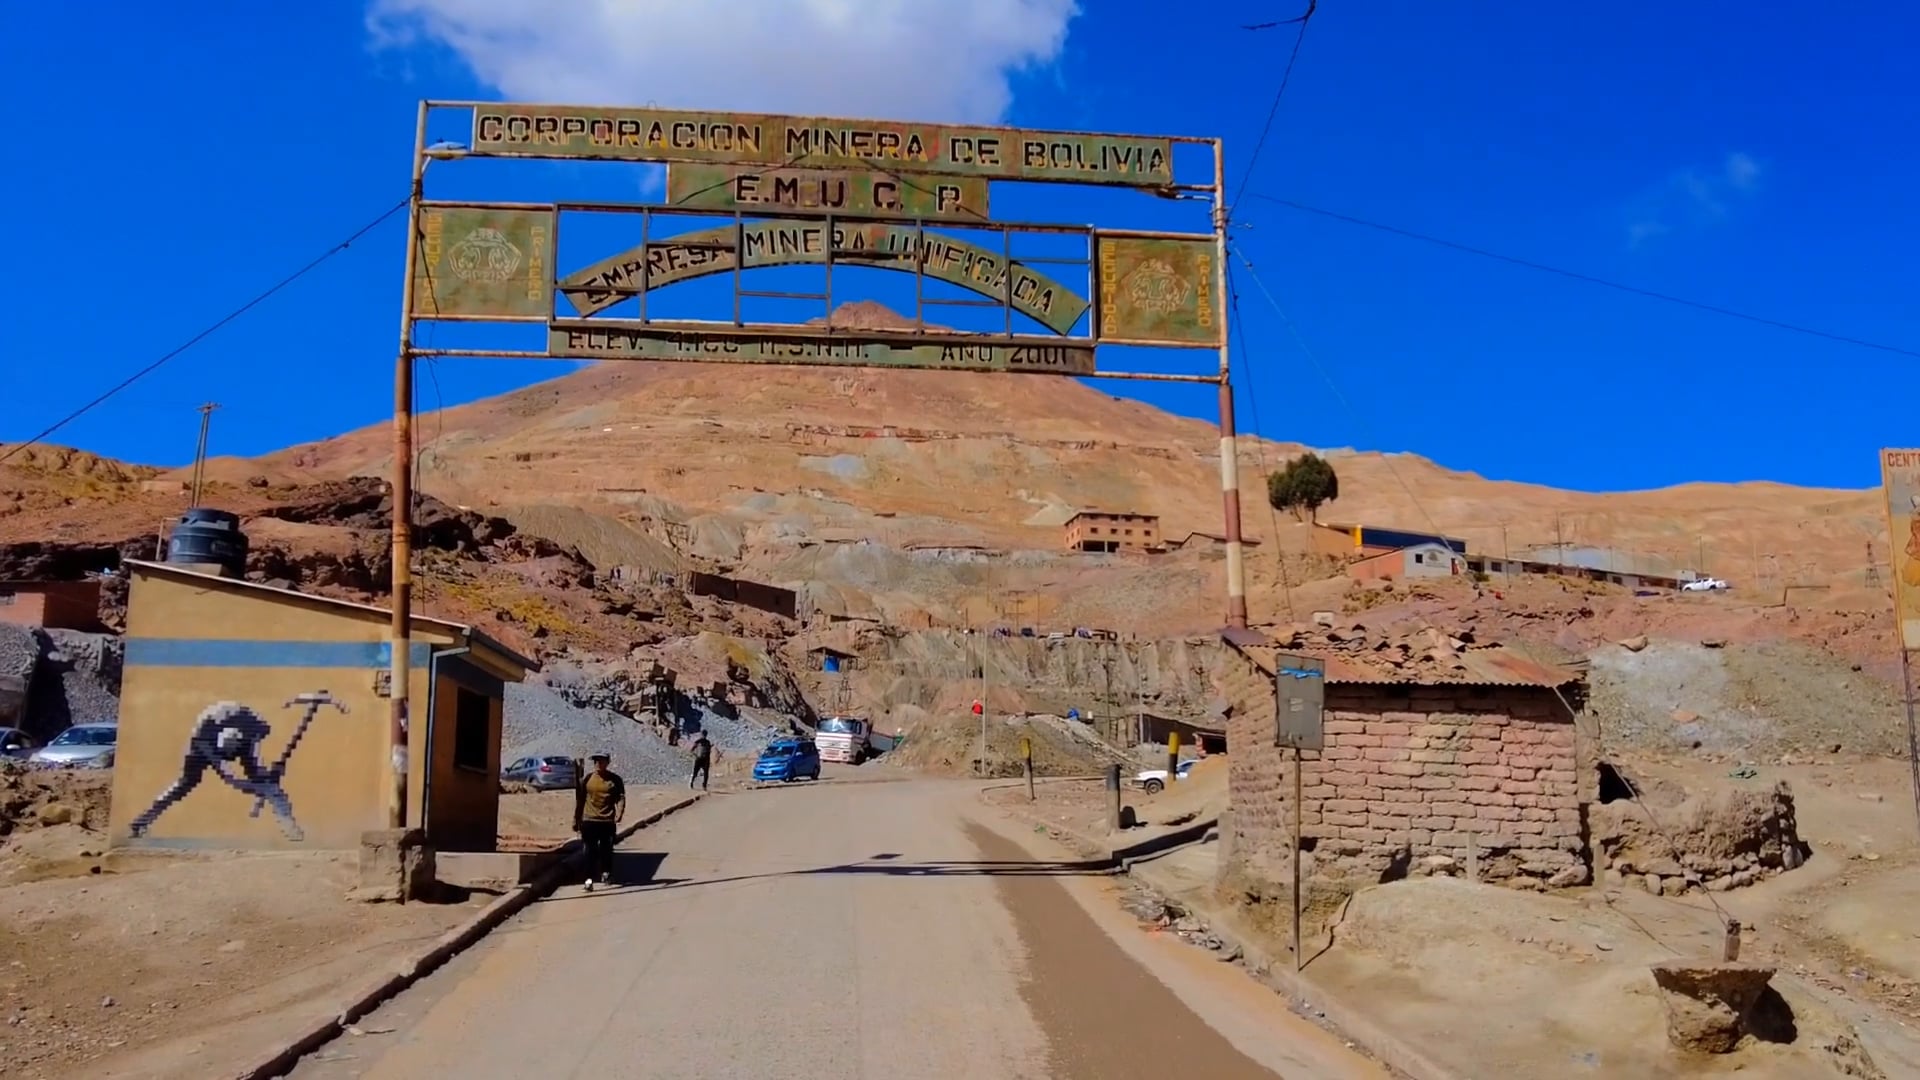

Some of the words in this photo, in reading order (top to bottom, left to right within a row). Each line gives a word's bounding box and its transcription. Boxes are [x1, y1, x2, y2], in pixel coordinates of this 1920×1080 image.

[479, 115, 762, 153] CORPORACION
[785, 126, 928, 162] MINERA
[949, 136, 1001, 167] DE
[1023, 140, 1170, 174] BOLIVIA
[583, 238, 728, 304] EMPRESA
[744, 227, 867, 259] MINERA
[888, 228, 1056, 316] UNIFICADA
[1887, 452, 1920, 467] CENT
